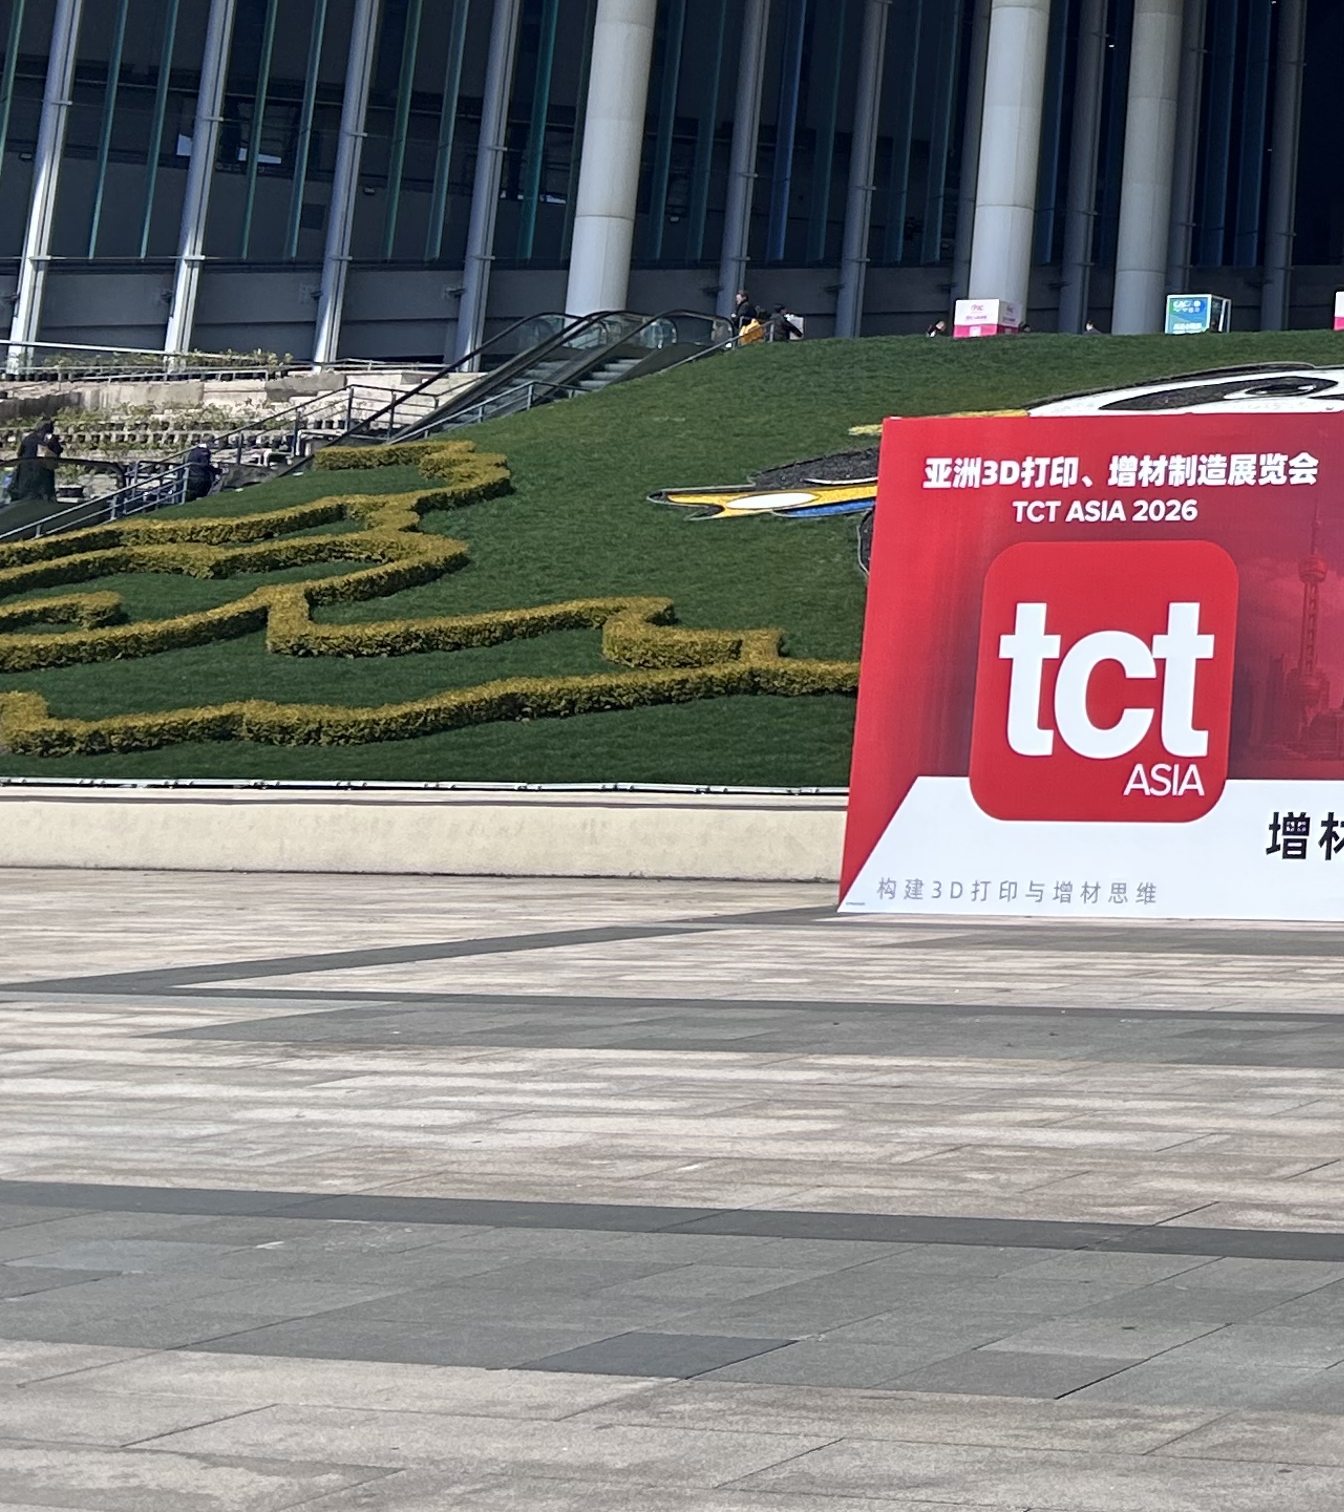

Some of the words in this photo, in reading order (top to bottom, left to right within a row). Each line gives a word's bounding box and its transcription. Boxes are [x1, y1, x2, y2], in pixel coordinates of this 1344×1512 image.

[923, 452, 1320, 489] 亚洲3D打印、增材制造展览会
[1012, 501, 1061, 524] TCT
[1066, 500, 1127, 523] ASIA
[1132, 499, 1199, 522] 2026
[999, 602, 1215, 758] tct
[1123, 764, 1205, 797] ASIA
[877, 877, 1157, 904] 构建3D打印与增材思维
